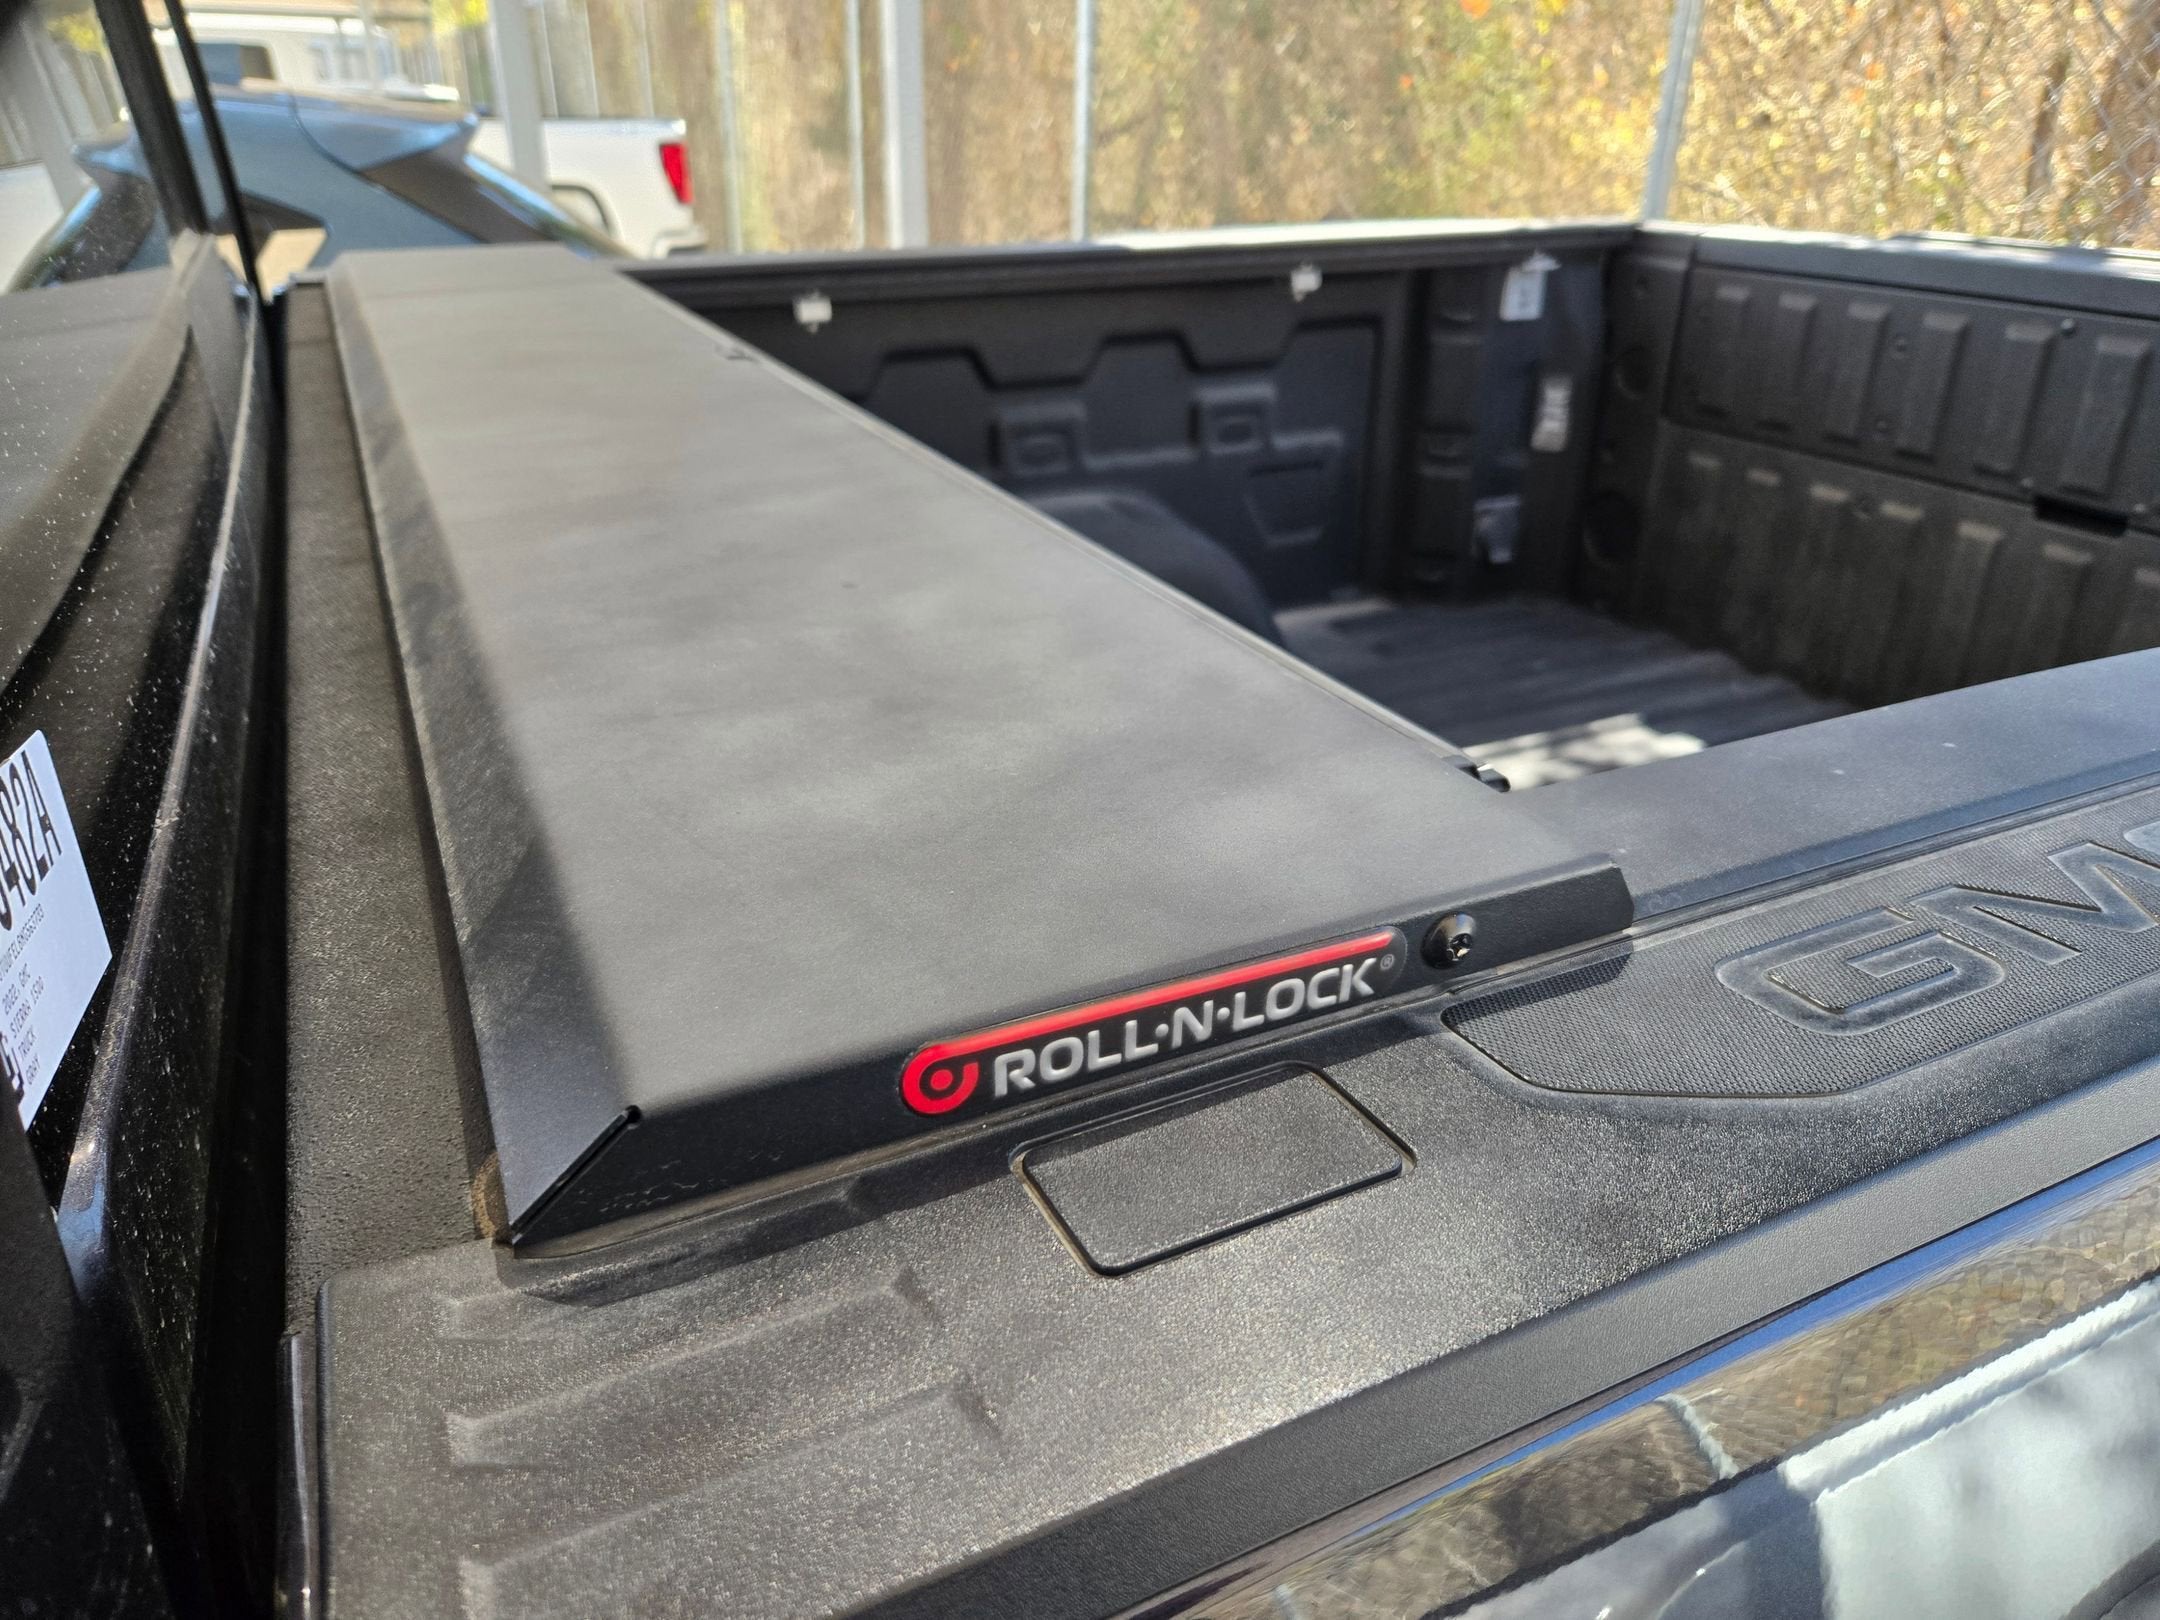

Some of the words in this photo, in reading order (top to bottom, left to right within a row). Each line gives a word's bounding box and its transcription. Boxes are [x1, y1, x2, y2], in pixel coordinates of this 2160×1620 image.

[0, 750, 62, 931] 482A
[1714, 818, 2160, 1037] GM
[19, 963, 31, 988] GMC
[10, 999, 32, 1038] SIERRA
[30, 976, 44, 1005] 1500
[18, 1025, 37, 1060] TRUCK
[26, 1053, 40, 1085] GRAY
